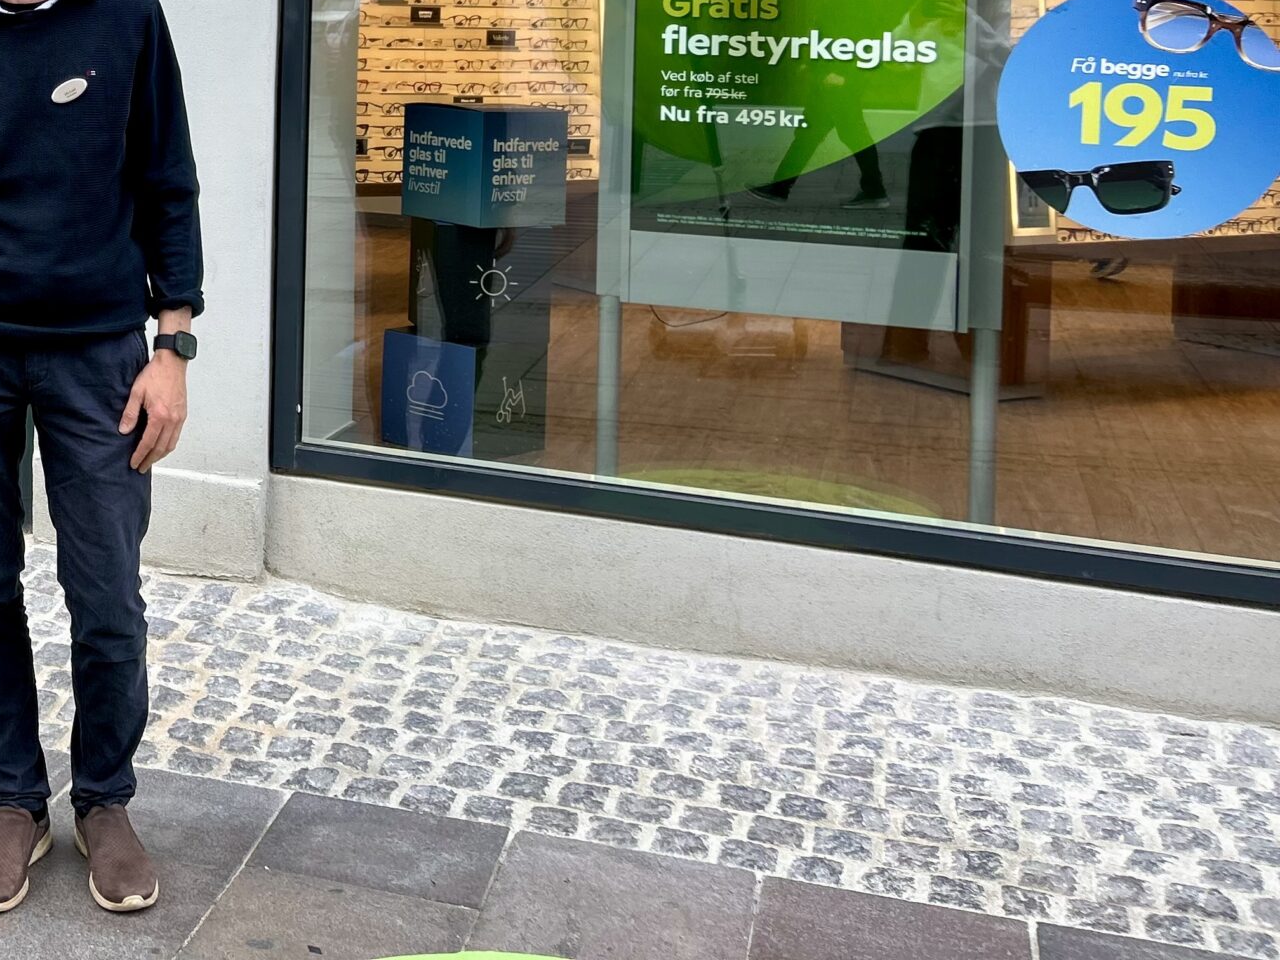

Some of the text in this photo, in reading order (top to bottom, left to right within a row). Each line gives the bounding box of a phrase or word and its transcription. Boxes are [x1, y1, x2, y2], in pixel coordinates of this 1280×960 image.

[662, 24, 938, 69] flerstyrkeglas
[1071, 57, 1097, 74] Få
[1100, 58, 1170, 80] begge
[661, 70, 759, 85] Ved køb af stel
[661, 86, 680, 98] før
[683, 86, 703, 98] fra
[660, 104, 690, 123] Nu
[696, 104, 729, 124] fra
[1069, 81, 1217, 152] 195
[410, 130, 472, 150] Indfarvede
[493, 138, 560, 152] Indfarvede
[409, 147, 446, 164] glas til
[493, 155, 534, 172] glas til
[409, 163, 448, 180] enhver
[492, 172, 536, 186] enhver
[408, 178, 441, 195] livsstil
[491, 188, 527, 203] livsstil
